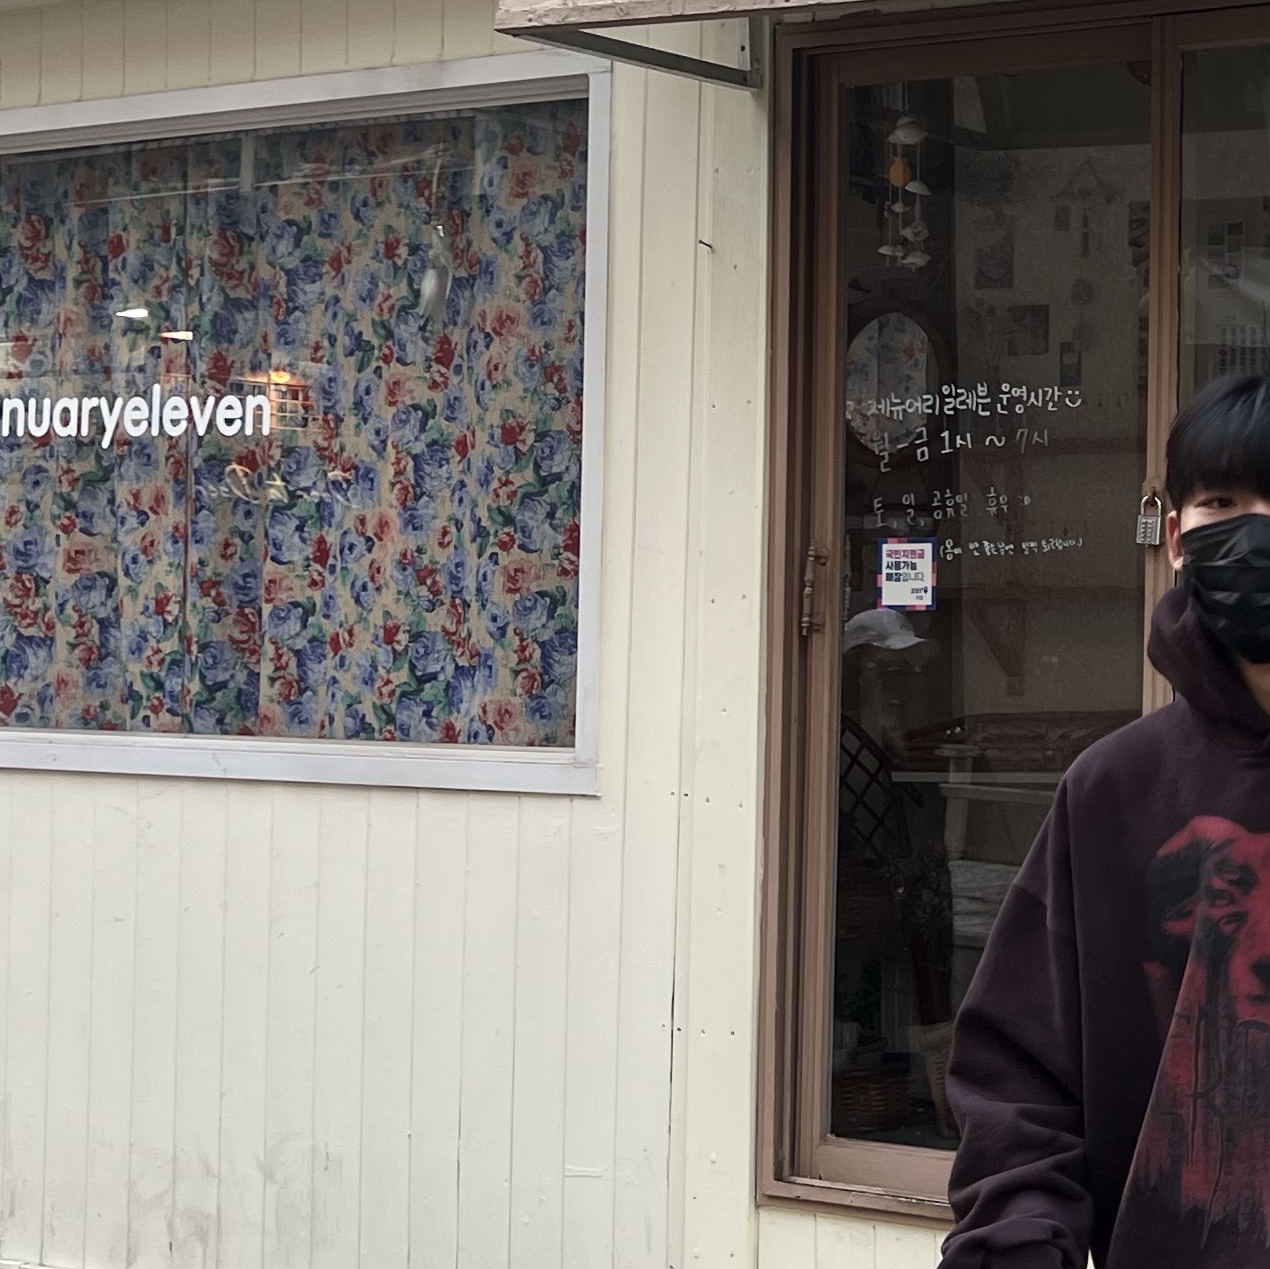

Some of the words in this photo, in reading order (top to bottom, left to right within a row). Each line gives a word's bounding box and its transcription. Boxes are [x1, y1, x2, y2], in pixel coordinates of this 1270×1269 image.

[996, 382, 1063, 415] 운영시간
[0, 383, 271, 450] nuaryeleven
[940, 430, 973, 454] 1시
[931, 488, 969, 519] 공휴일
